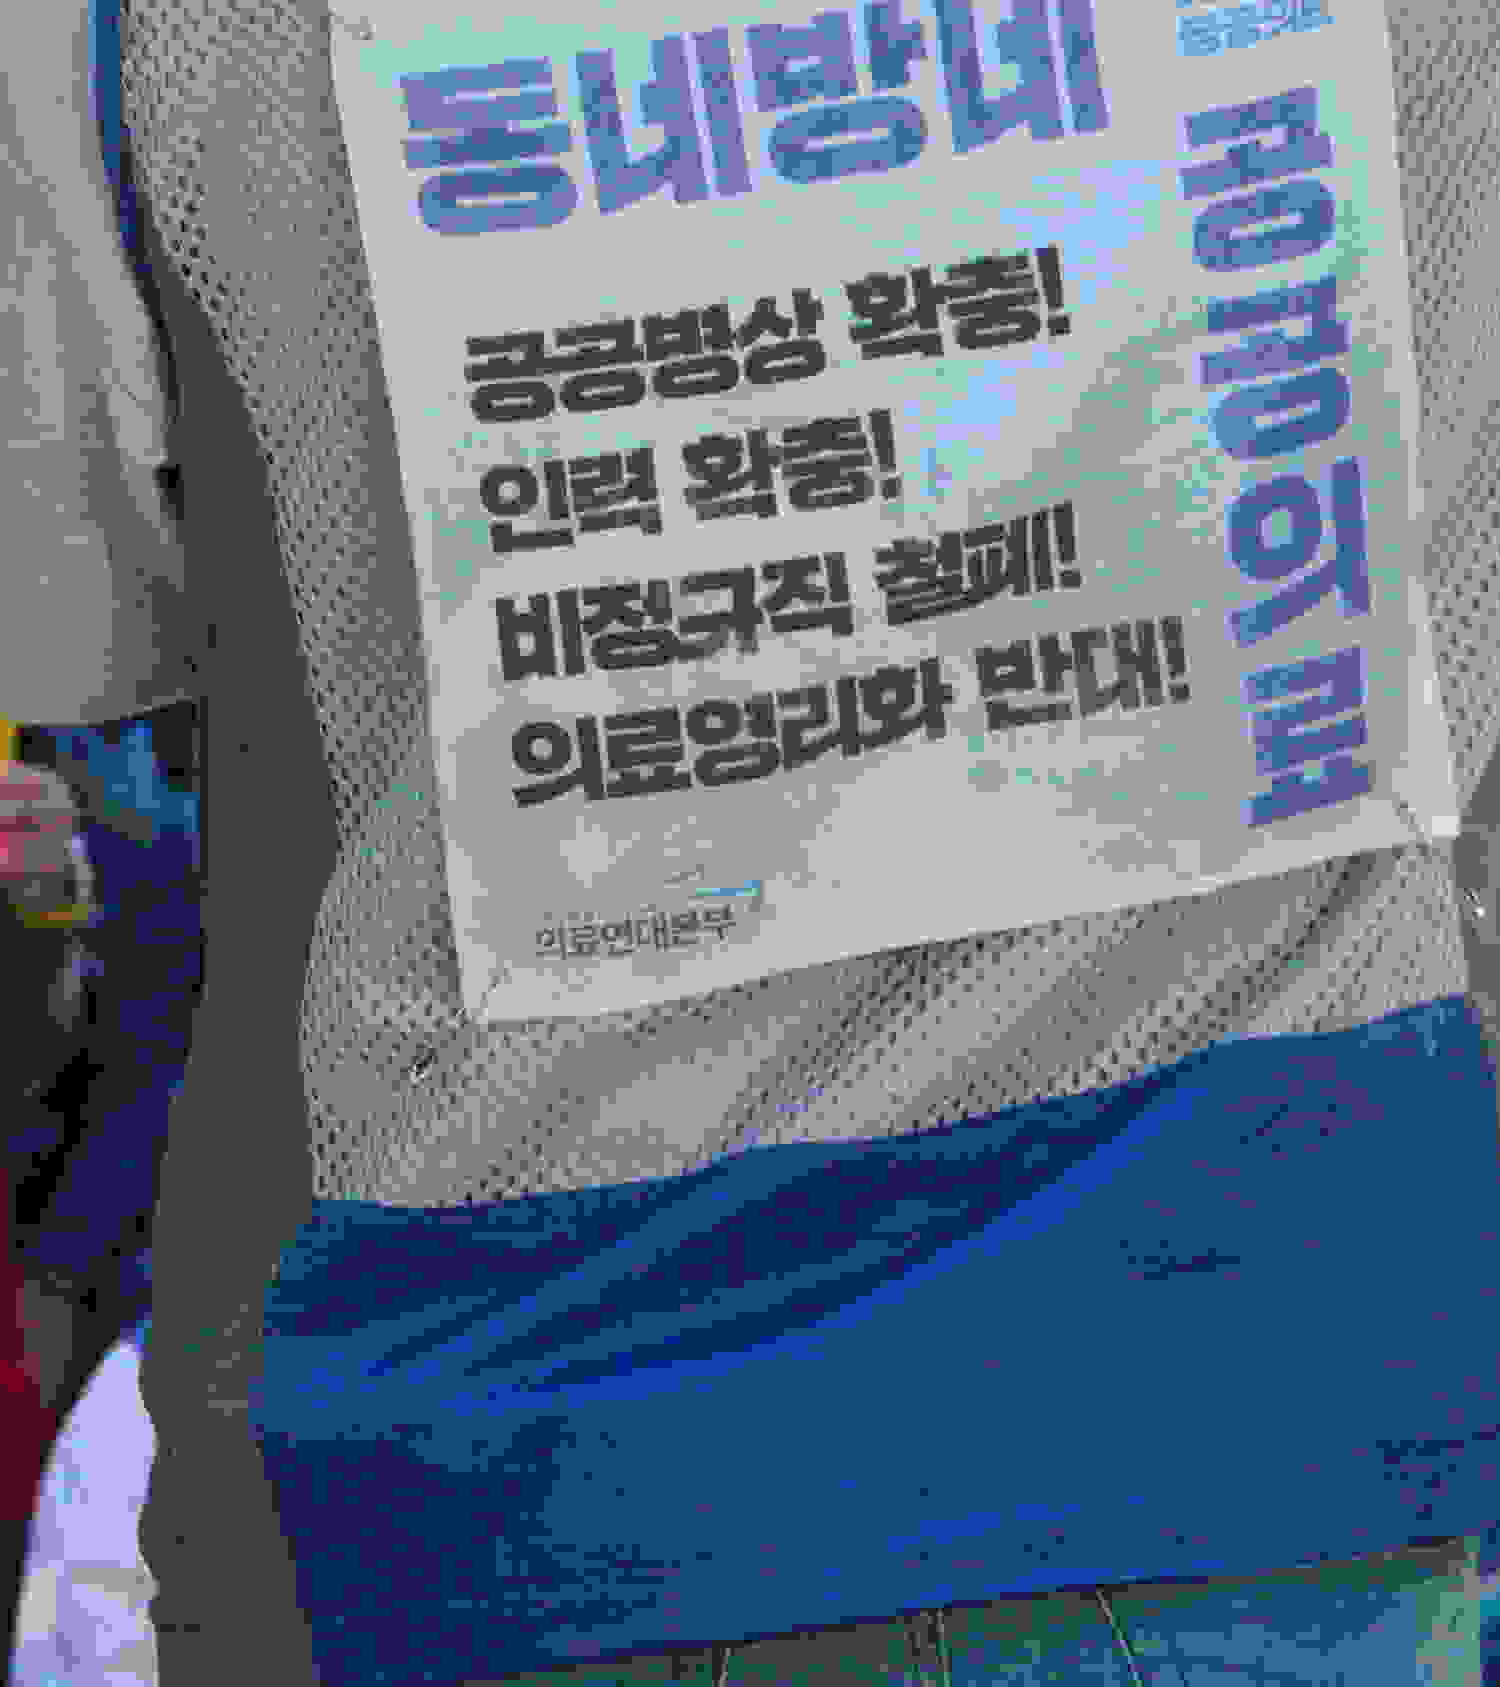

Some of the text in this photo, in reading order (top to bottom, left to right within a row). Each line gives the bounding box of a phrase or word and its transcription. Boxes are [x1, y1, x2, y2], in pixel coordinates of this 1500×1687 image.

[462, 243, 1073, 424] 공공병상 확충!
[478, 407, 902, 554] 인력 확충!
[1177, 86, 1370, 826] 공공의료
[495, 502, 1082, 681] 비정규직 철폐!
[511, 615, 1191, 809] 의료영리화 반대!
